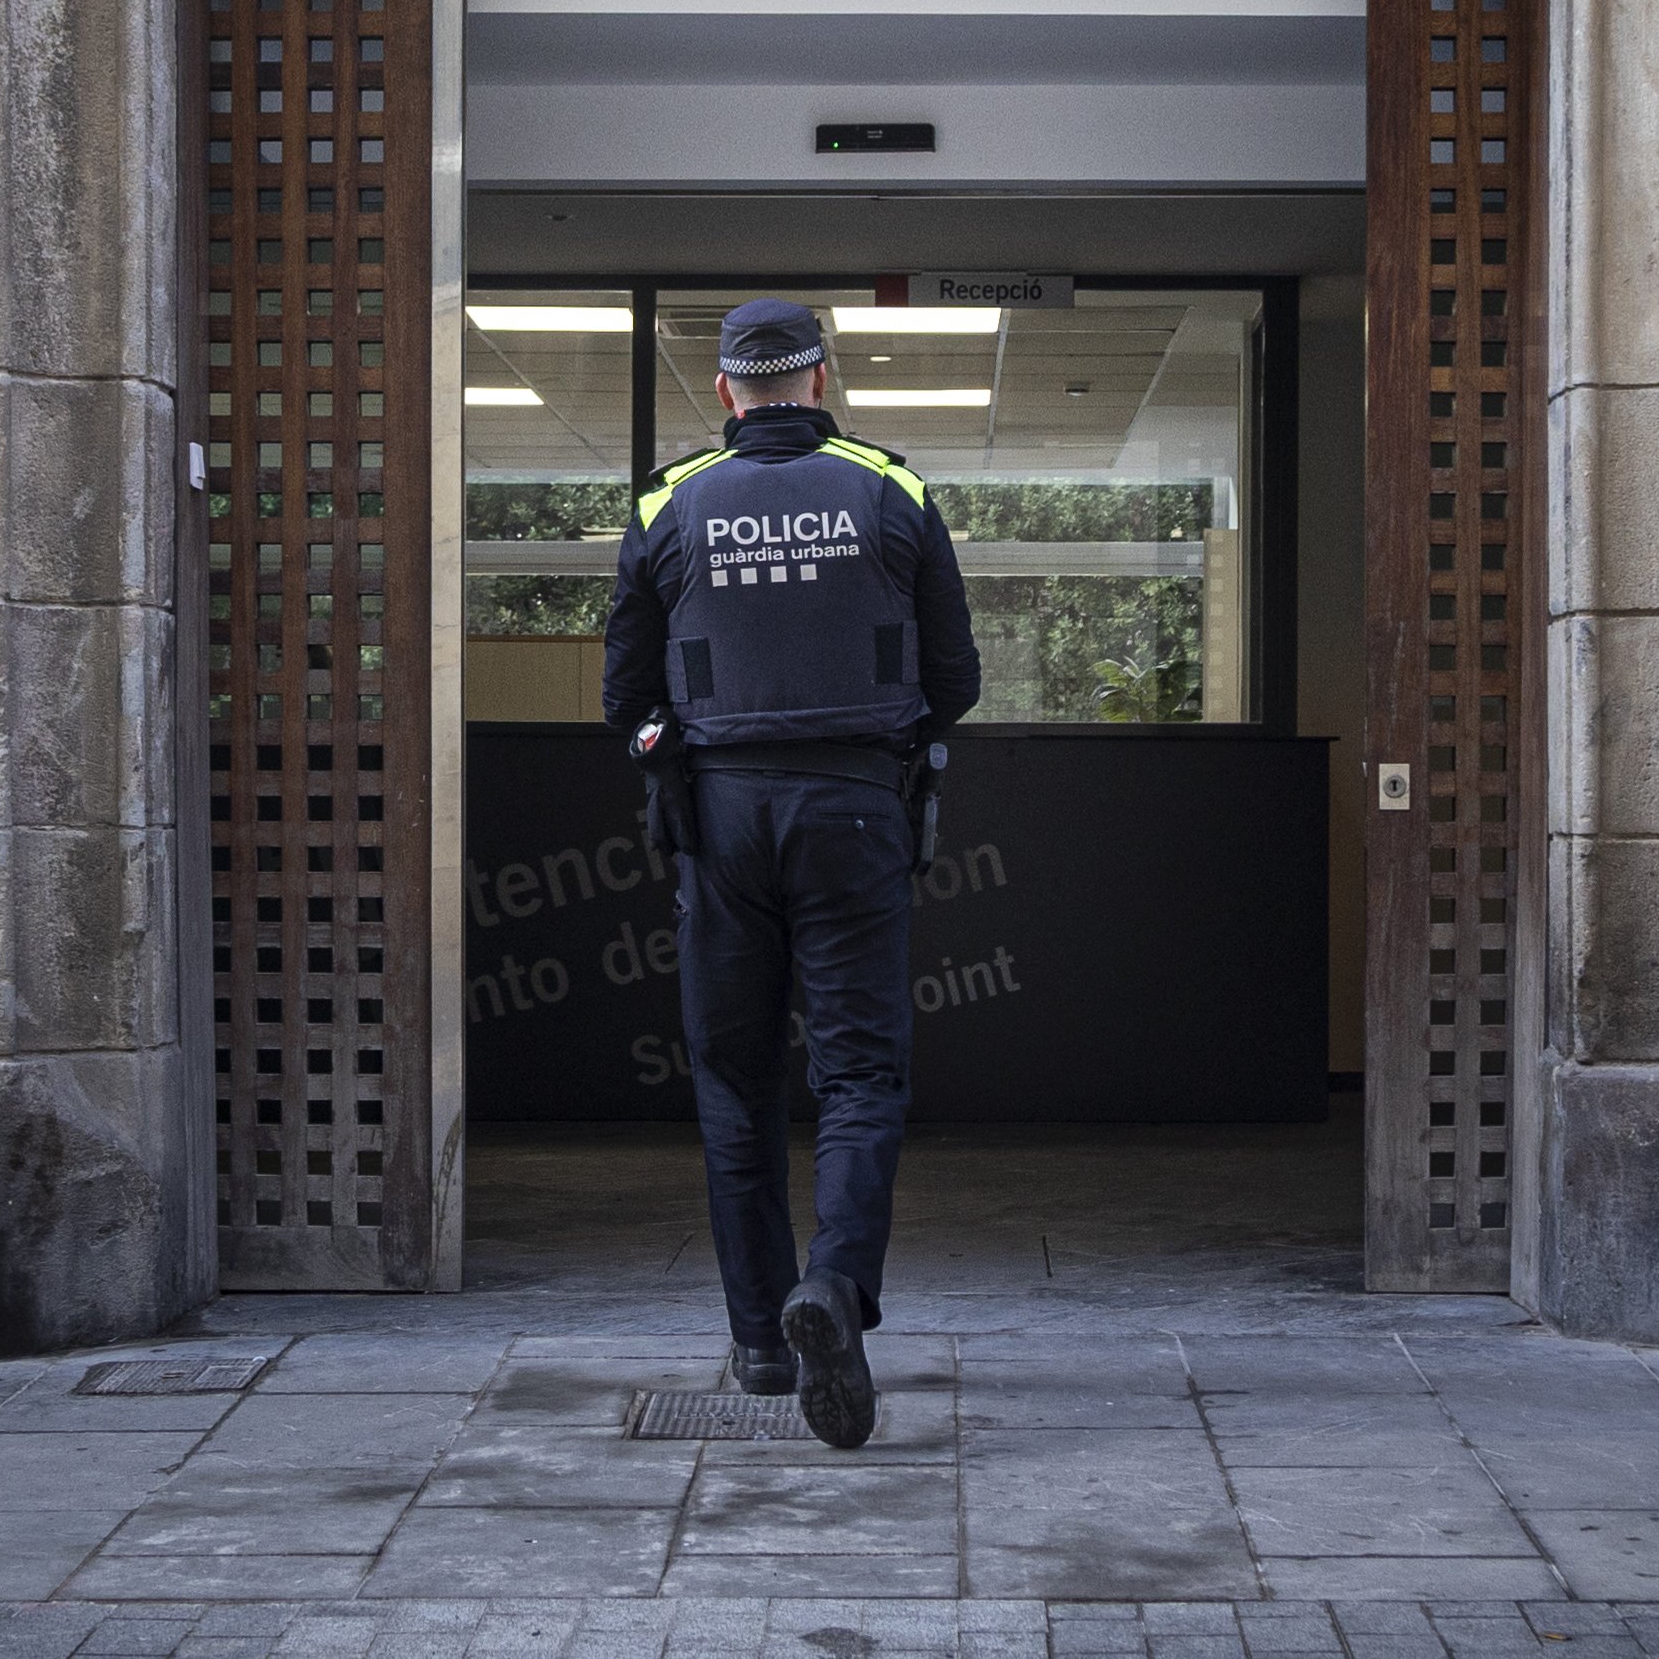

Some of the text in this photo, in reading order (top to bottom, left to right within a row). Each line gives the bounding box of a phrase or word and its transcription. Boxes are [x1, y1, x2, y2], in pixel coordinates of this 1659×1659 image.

[939, 279, 1044, 305] Recepció
[706, 509, 859, 546] POLICIA
[709, 542, 860, 568] guàrdia urbana
[465, 954, 570, 1025] nto
[912, 946, 1022, 1014] oint
